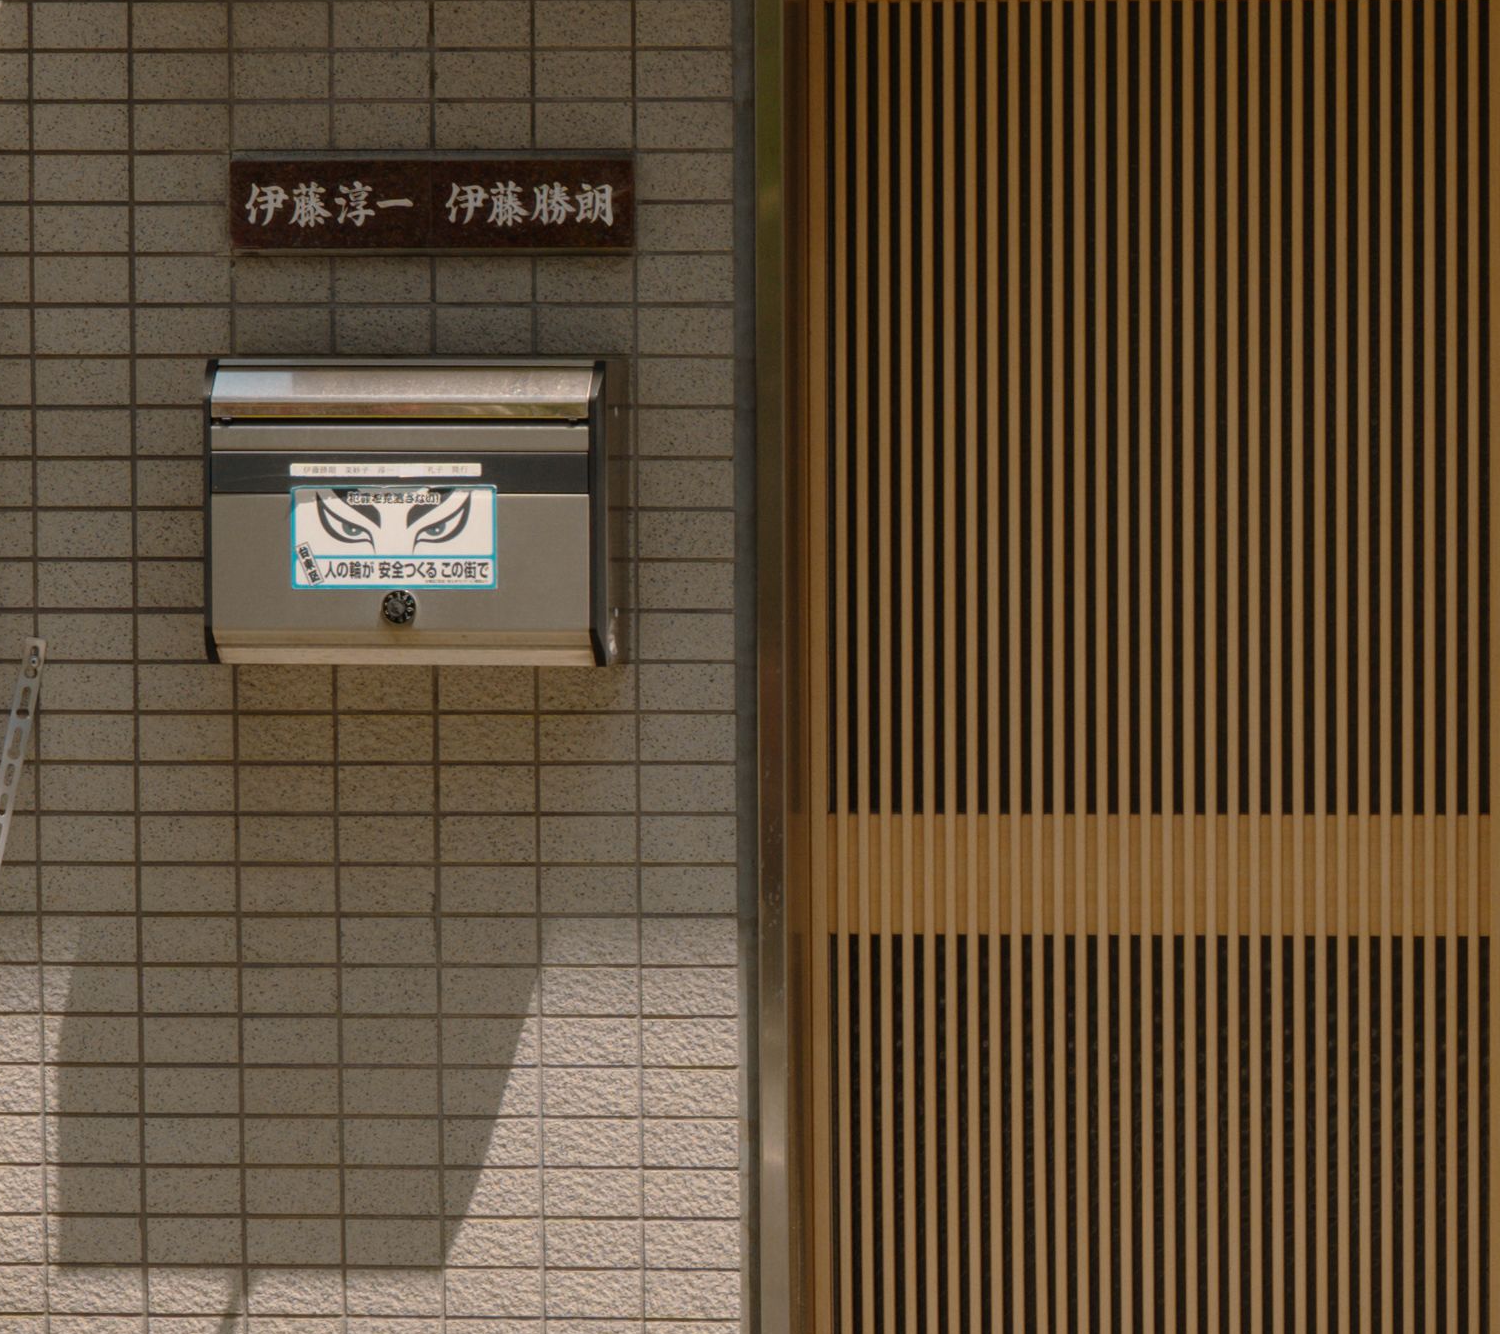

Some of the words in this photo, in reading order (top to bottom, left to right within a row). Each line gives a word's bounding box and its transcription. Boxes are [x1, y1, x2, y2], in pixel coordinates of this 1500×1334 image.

[245, 180, 414, 227] 伊藤淳一
[445, 180, 614, 227] 伊藤勝朗
[324, 561, 375, 579] 人の輪が
[379, 561, 438, 579] 安全つくる
[441, 561, 489, 579] この街で
